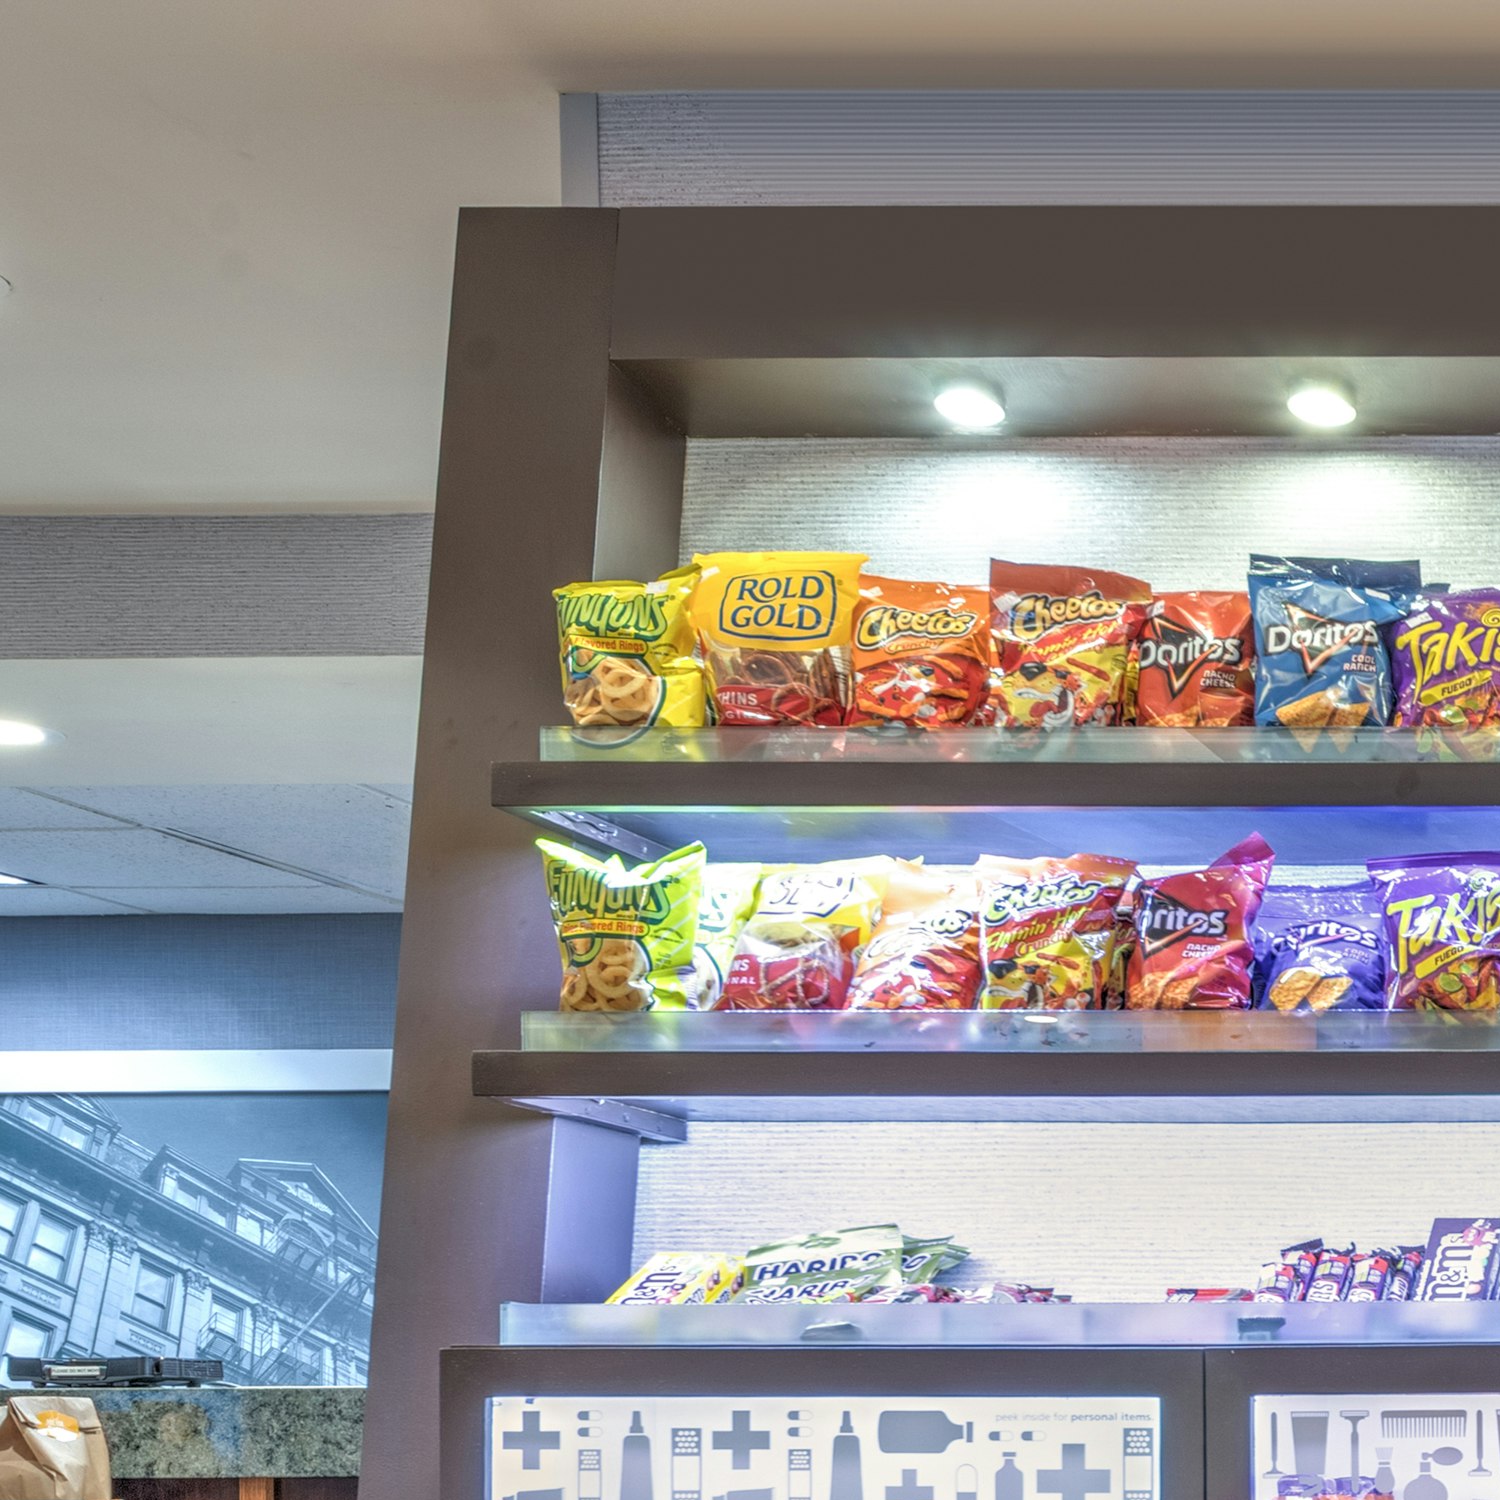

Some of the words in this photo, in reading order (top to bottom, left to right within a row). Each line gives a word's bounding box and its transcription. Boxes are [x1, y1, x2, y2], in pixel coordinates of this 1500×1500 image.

[736, 576, 825, 601] ROLD
[730, 604, 822, 630] GOLD
[856, 607, 977, 650] Cheetos
[1012, 591, 1126, 641] Cheetos
[1266, 620, 1378, 655] Doritos
[1139, 638, 1242, 668] Doritos
[1442, 679, 1473, 696] FUEGO
[984, 873, 1102, 924] Cheetos
[1434, 945, 1465, 964] FUEGO
[756, 1251, 884, 1281] HARIBO
[995, 1413, 1017, 1422] peek
[1022, 1412, 1050, 1421] inside
[1054, 1412, 1067, 1421] for
[1071, 1412, 1118, 1422] personal
[1121, 1412, 1154, 1421] items.
